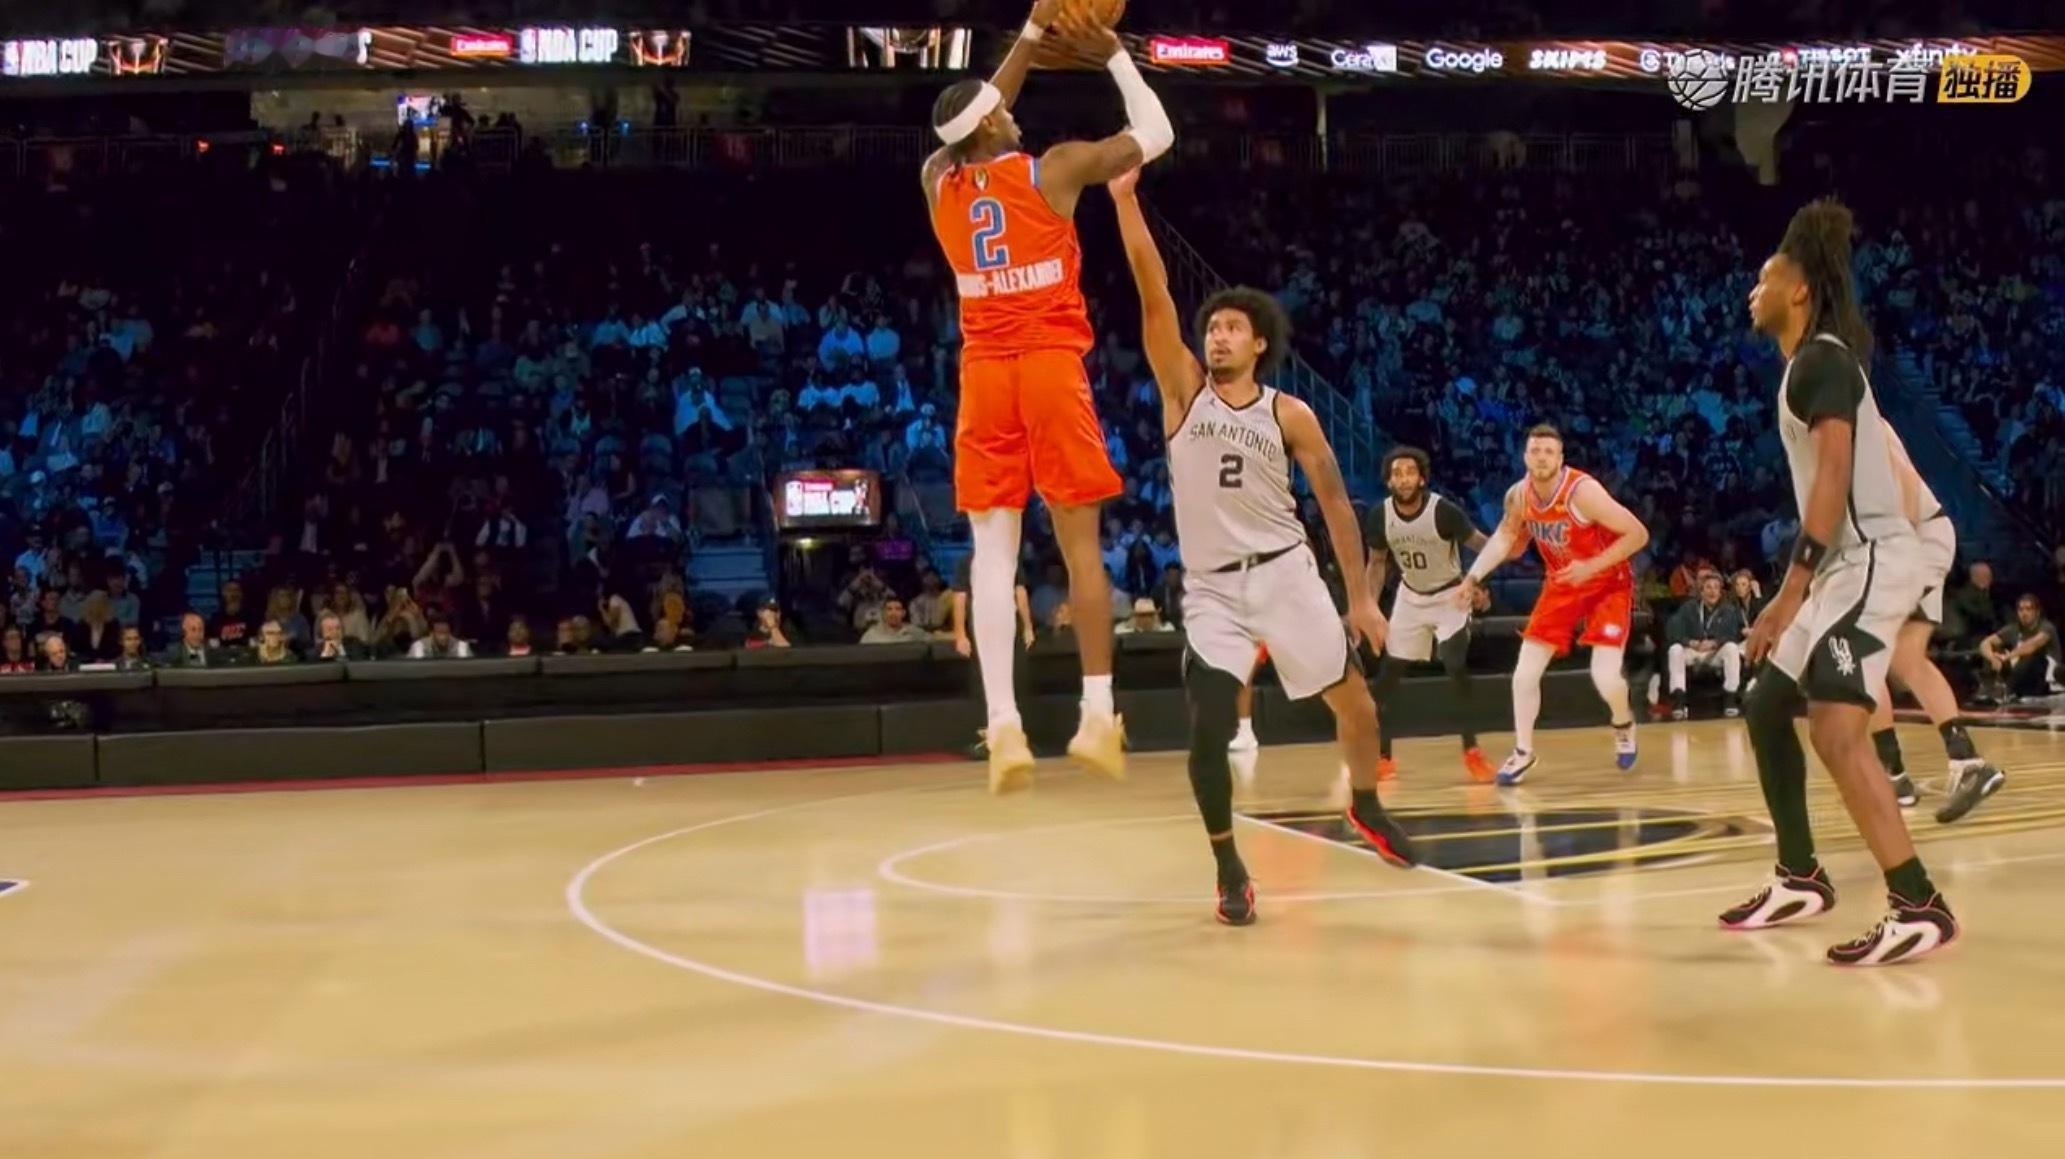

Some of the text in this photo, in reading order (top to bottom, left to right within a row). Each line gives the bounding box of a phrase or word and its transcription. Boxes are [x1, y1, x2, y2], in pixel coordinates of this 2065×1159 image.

[59, 38, 98, 73] CUP
[537, 28, 618, 63] NBA CUP
[1156, 43, 1224, 60] Emirates
[1266, 43, 1297, 58] aws
[1426, 48, 1503, 72] Google
[970, 197, 1010, 271] 2
[1189, 421, 1277, 462] SAN ANTONIO
[1219, 453, 1243, 488] 2
[1400, 551, 1427, 569] 30
